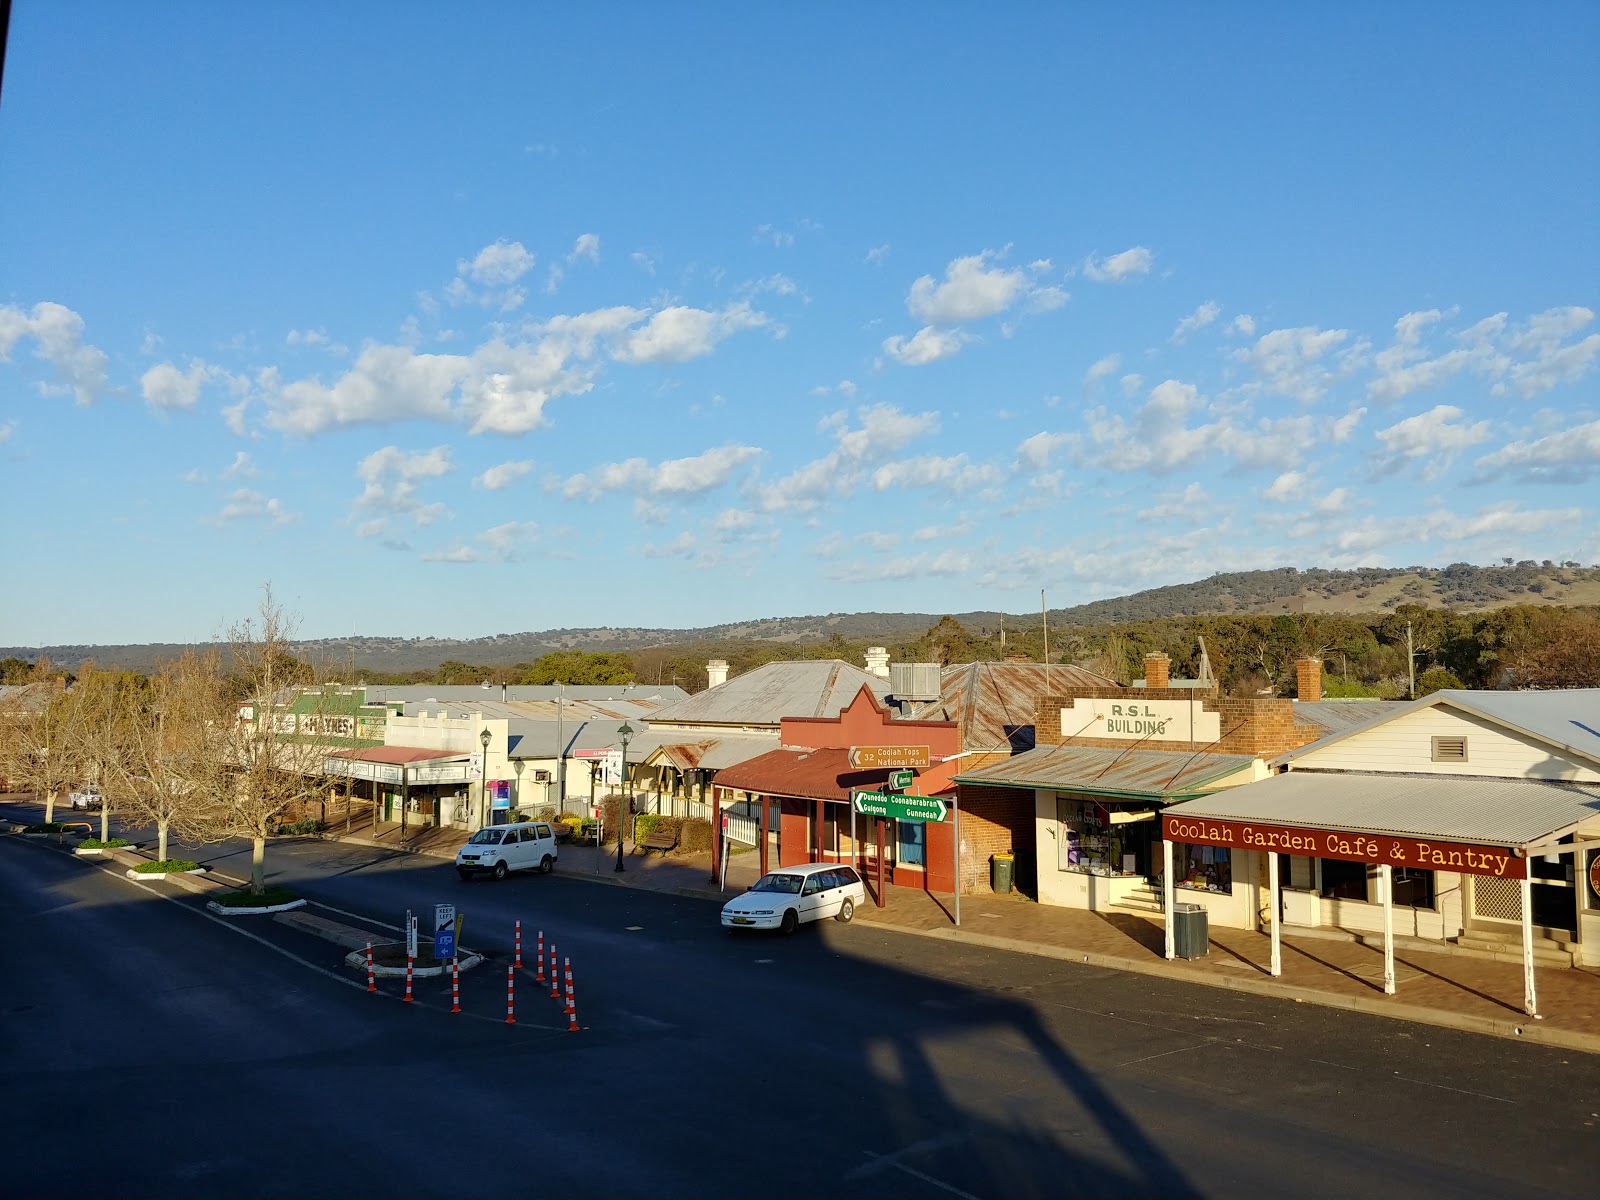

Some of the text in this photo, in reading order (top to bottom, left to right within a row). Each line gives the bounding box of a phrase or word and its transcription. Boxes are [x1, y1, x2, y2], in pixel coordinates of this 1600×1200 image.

[1107, 718, 1166, 735] BUILDING
[877, 748, 901, 756] Coolah
[904, 748, 920, 756] Tops
[877, 758, 908, 766] National
[863, 793, 937, 808] Dunedoo Coonabarabran
[863, 804, 937, 819] Gulgong Gunnedah
[1169, 819, 1509, 876] Coolah Garden Café & Pantry
